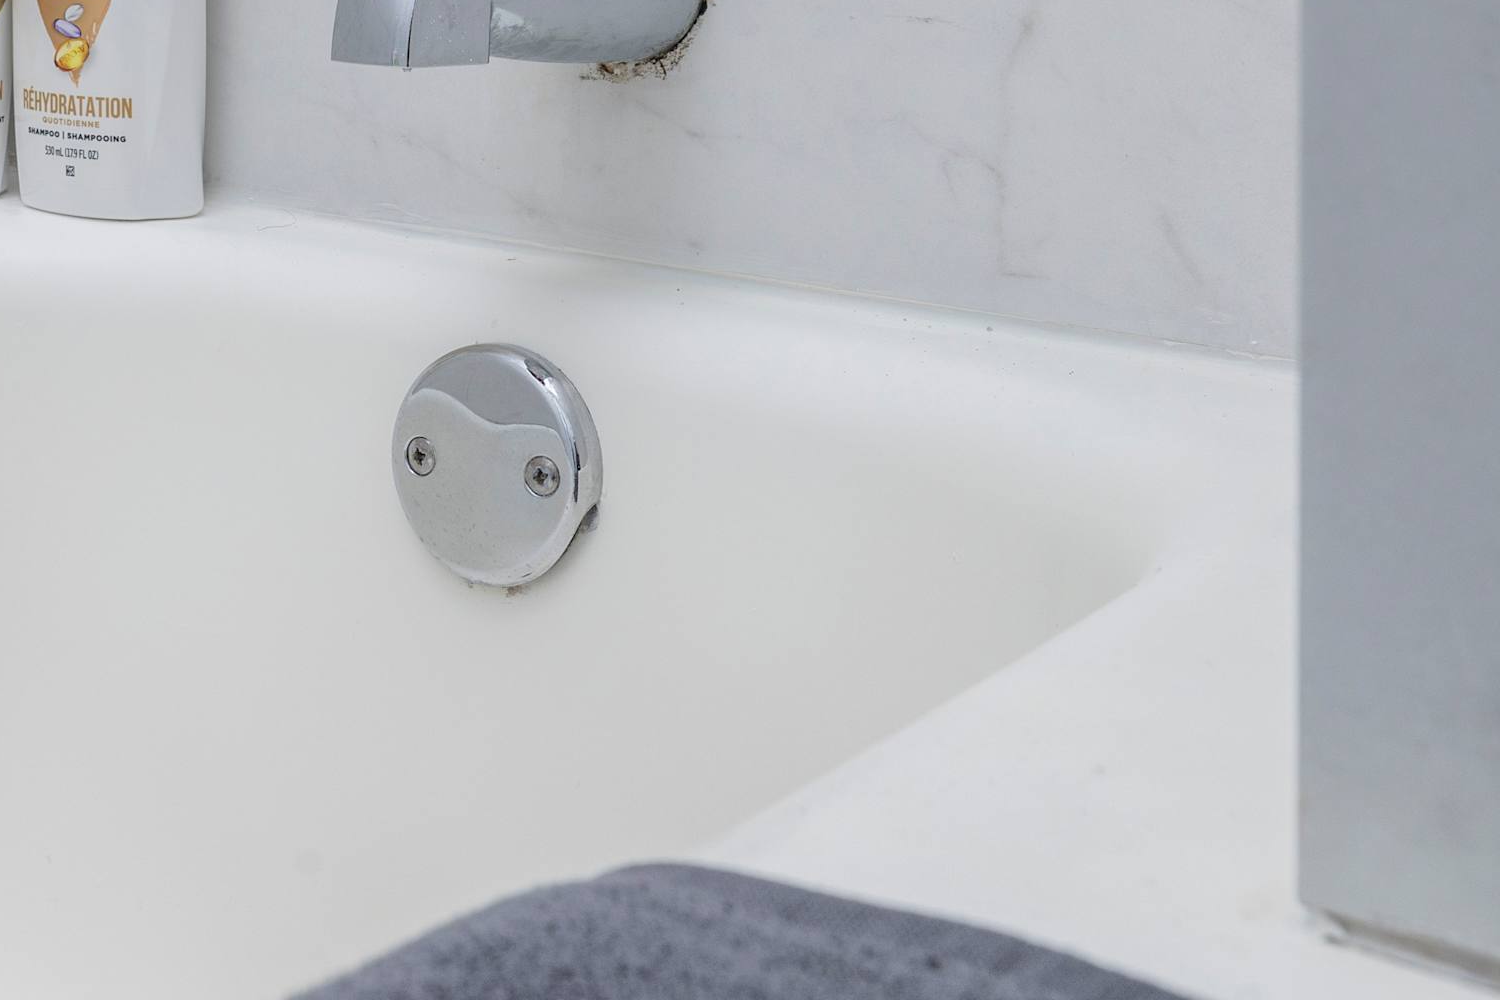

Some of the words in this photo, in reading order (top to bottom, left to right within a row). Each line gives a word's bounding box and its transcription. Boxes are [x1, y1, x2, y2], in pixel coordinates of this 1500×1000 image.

[22, 85, 133, 119] RÉHYDRATATION
[42, 116, 101, 129] QUOTIDIENNE
[27, 126, 60, 138] SHAMPOO
[67, 132, 127, 143] SHAMPOOING
